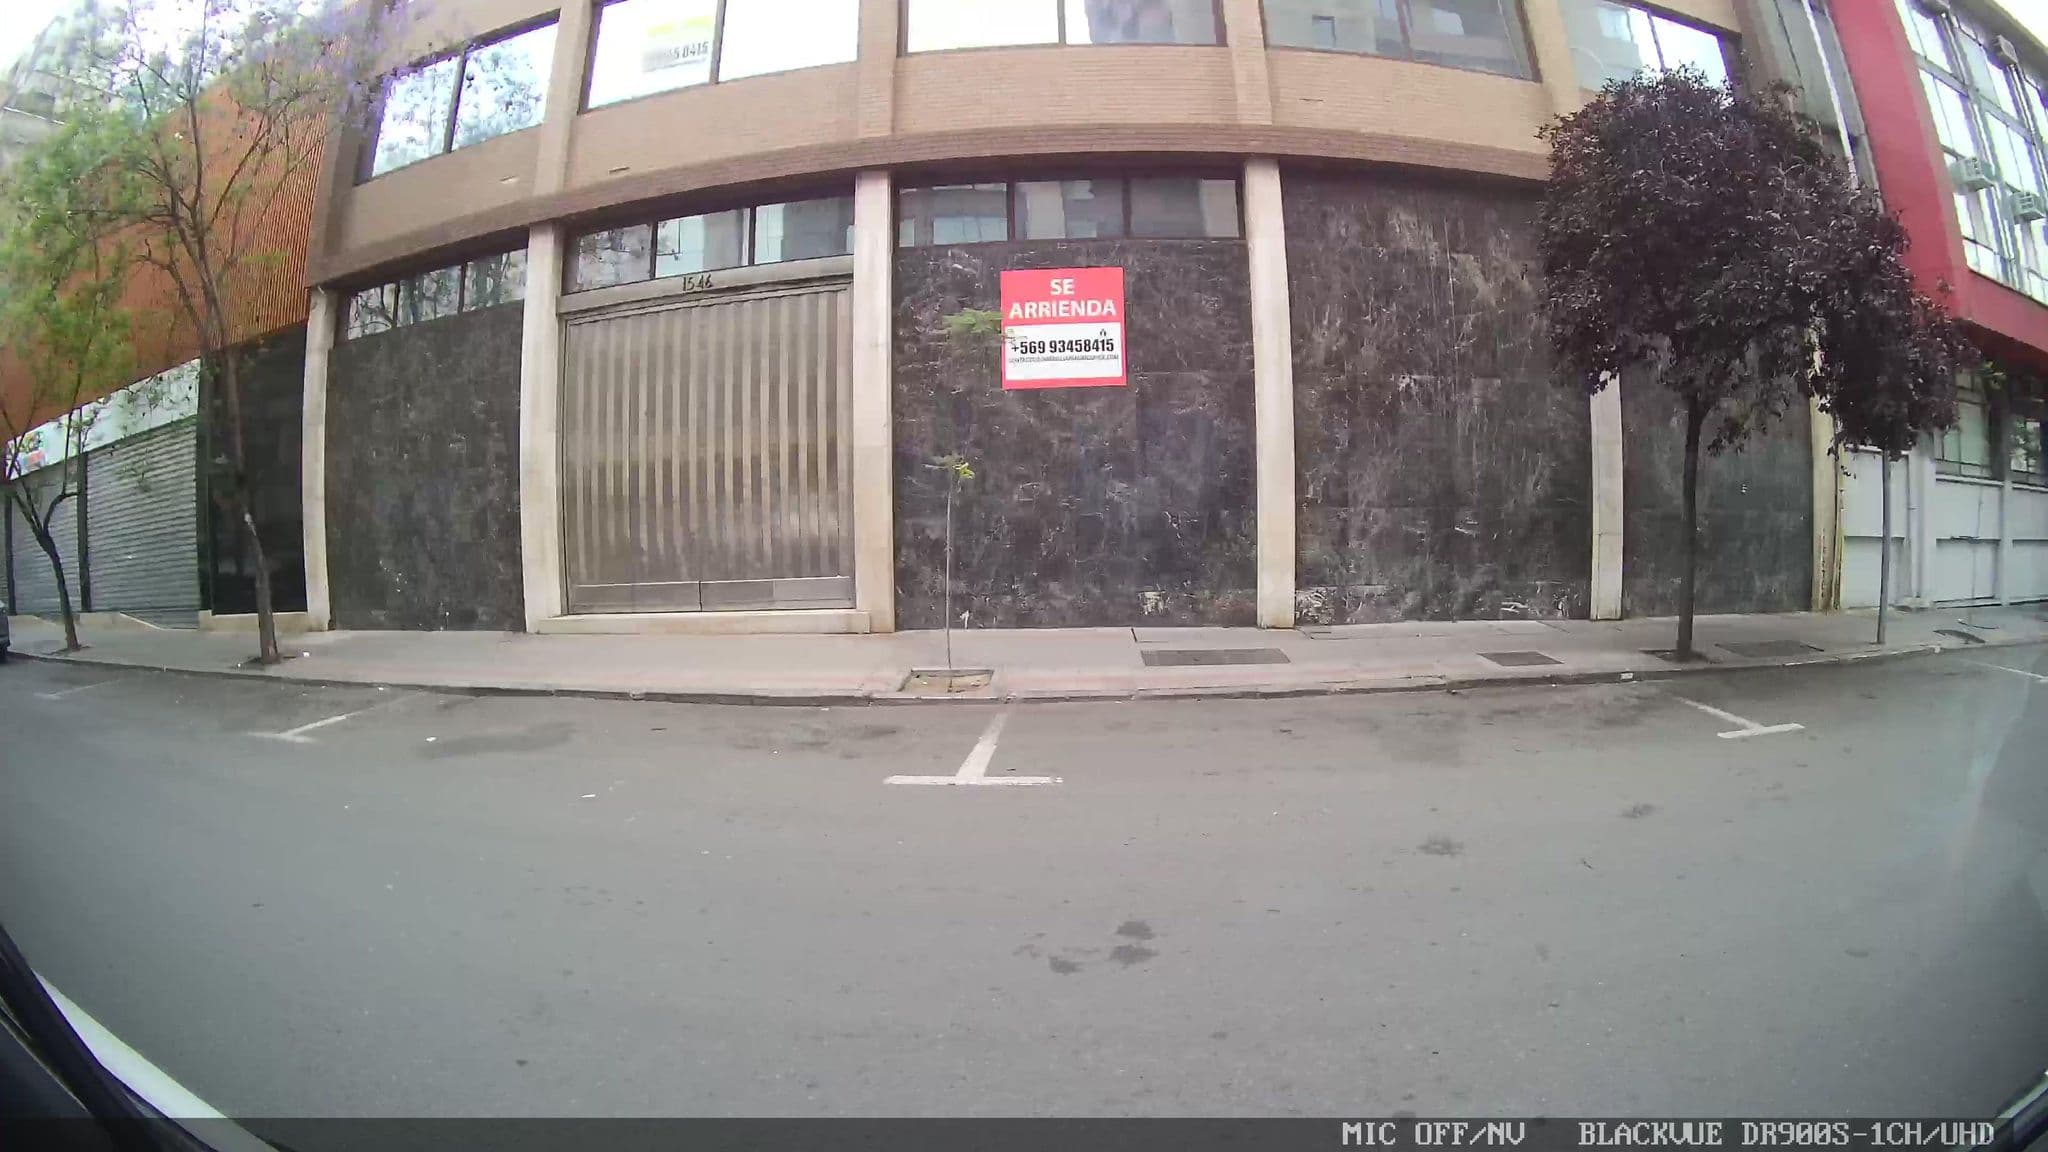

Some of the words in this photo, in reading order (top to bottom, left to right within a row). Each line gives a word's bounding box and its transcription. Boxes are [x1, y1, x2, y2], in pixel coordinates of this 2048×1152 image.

[683, 274, 712, 291] 1546
[1050, 278, 1075, 296] SE
[1009, 299, 1117, 320] ARRIENDA
[1011, 340, 1046, 355] +569
[1049, 338, 1114, 353] 93458415
